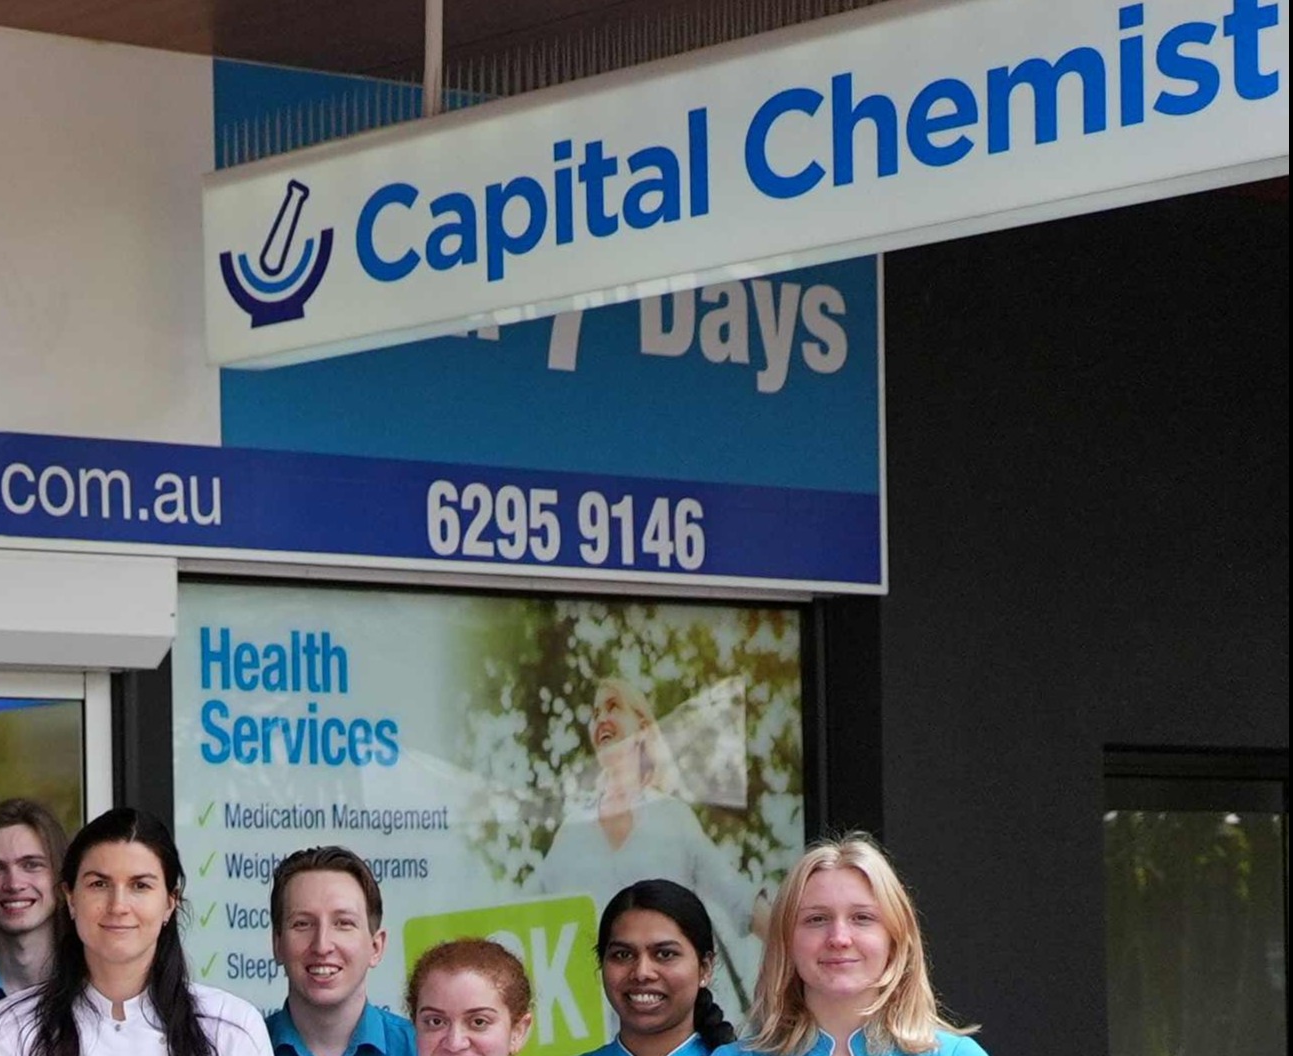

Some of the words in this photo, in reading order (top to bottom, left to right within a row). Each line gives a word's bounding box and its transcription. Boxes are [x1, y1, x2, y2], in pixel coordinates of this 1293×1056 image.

[355, 107, 710, 283] Capital
[744, 0, 1280, 200] Chemist
[426, 479, 561, 564] 6295
[577, 490, 706, 570] 9146
[199, 626, 349, 694] Health
[200, 699, 398, 766] Services
[224, 802, 326, 830] Medication
[332, 803, 449, 836] Management
[227, 952, 279, 984] Sleep
